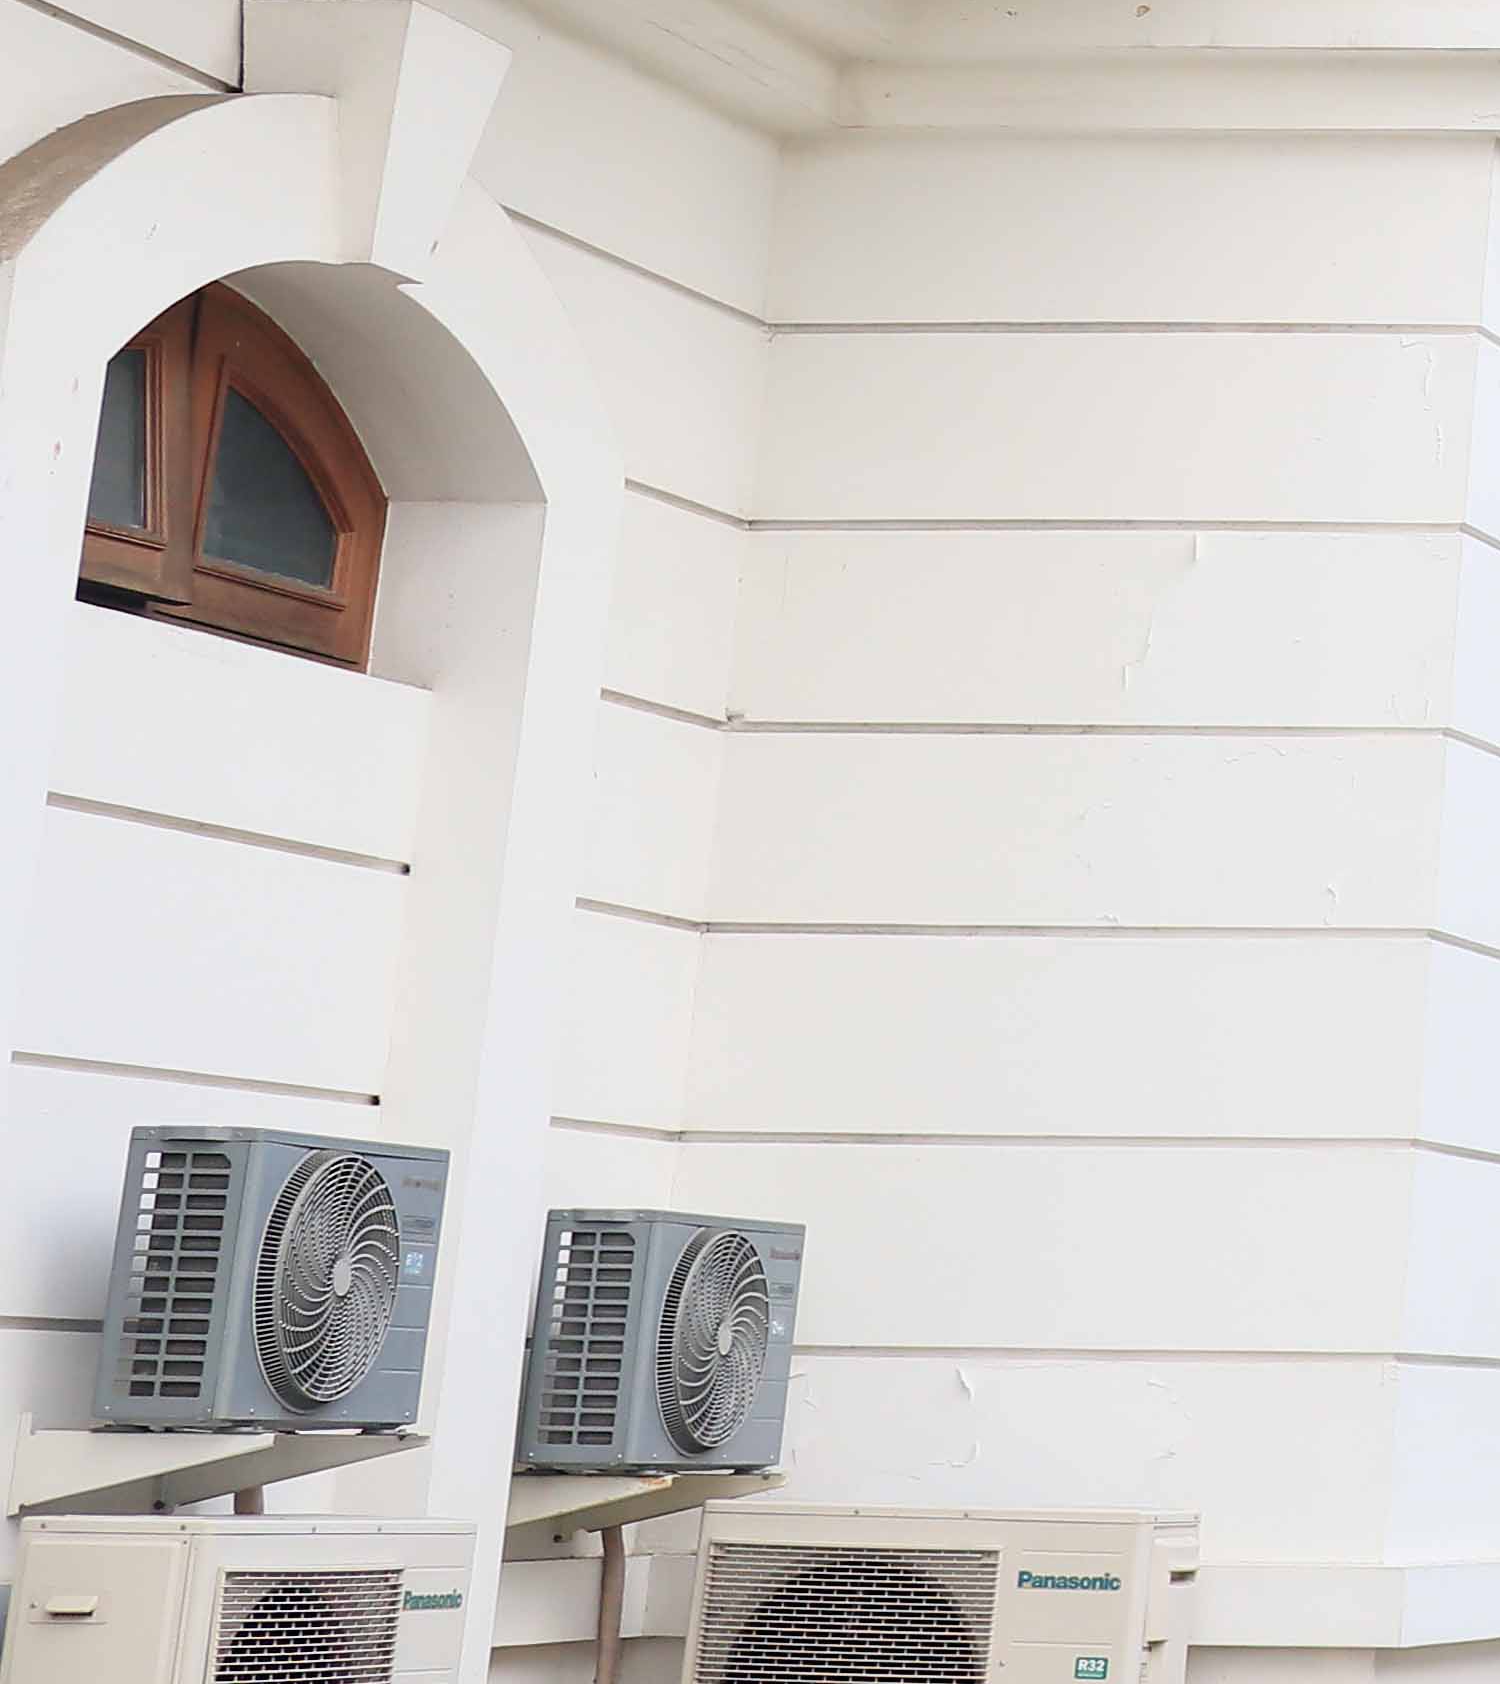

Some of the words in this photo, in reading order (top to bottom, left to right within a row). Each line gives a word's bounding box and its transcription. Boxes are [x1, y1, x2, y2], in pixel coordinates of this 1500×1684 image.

[1017, 1570, 1121, 1590] Panasonic
[403, 1588, 463, 1611] Panasonic
[1077, 1659, 1105, 1671] R32
